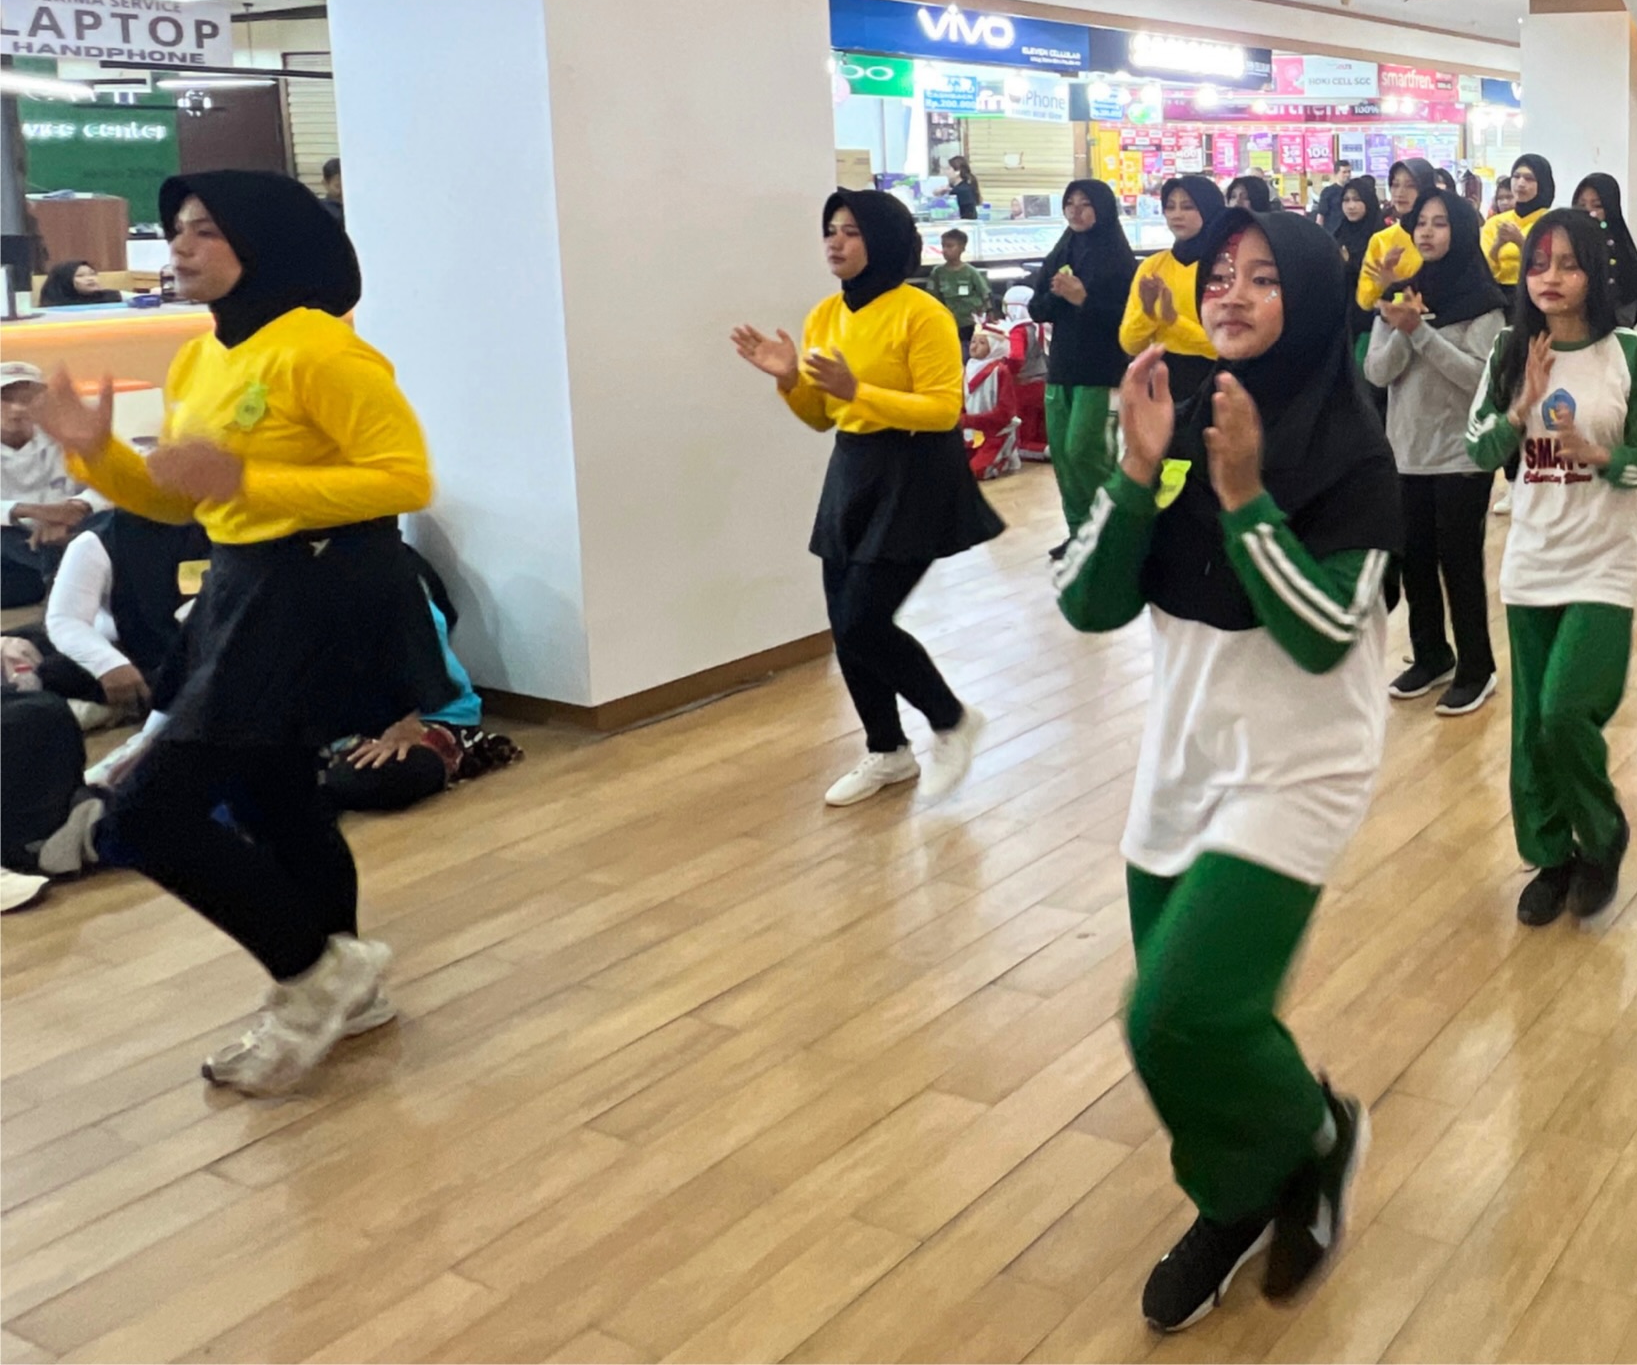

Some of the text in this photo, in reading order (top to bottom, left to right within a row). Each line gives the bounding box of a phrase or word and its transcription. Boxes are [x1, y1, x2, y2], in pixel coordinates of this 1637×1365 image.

[0, 6, 220, 50] LAPTOP
[916, 3, 1016, 50] vivo
[12, 40, 206, 66] HANDPHONE
[1307, 77, 1372, 86] HOKI CELL SGC
